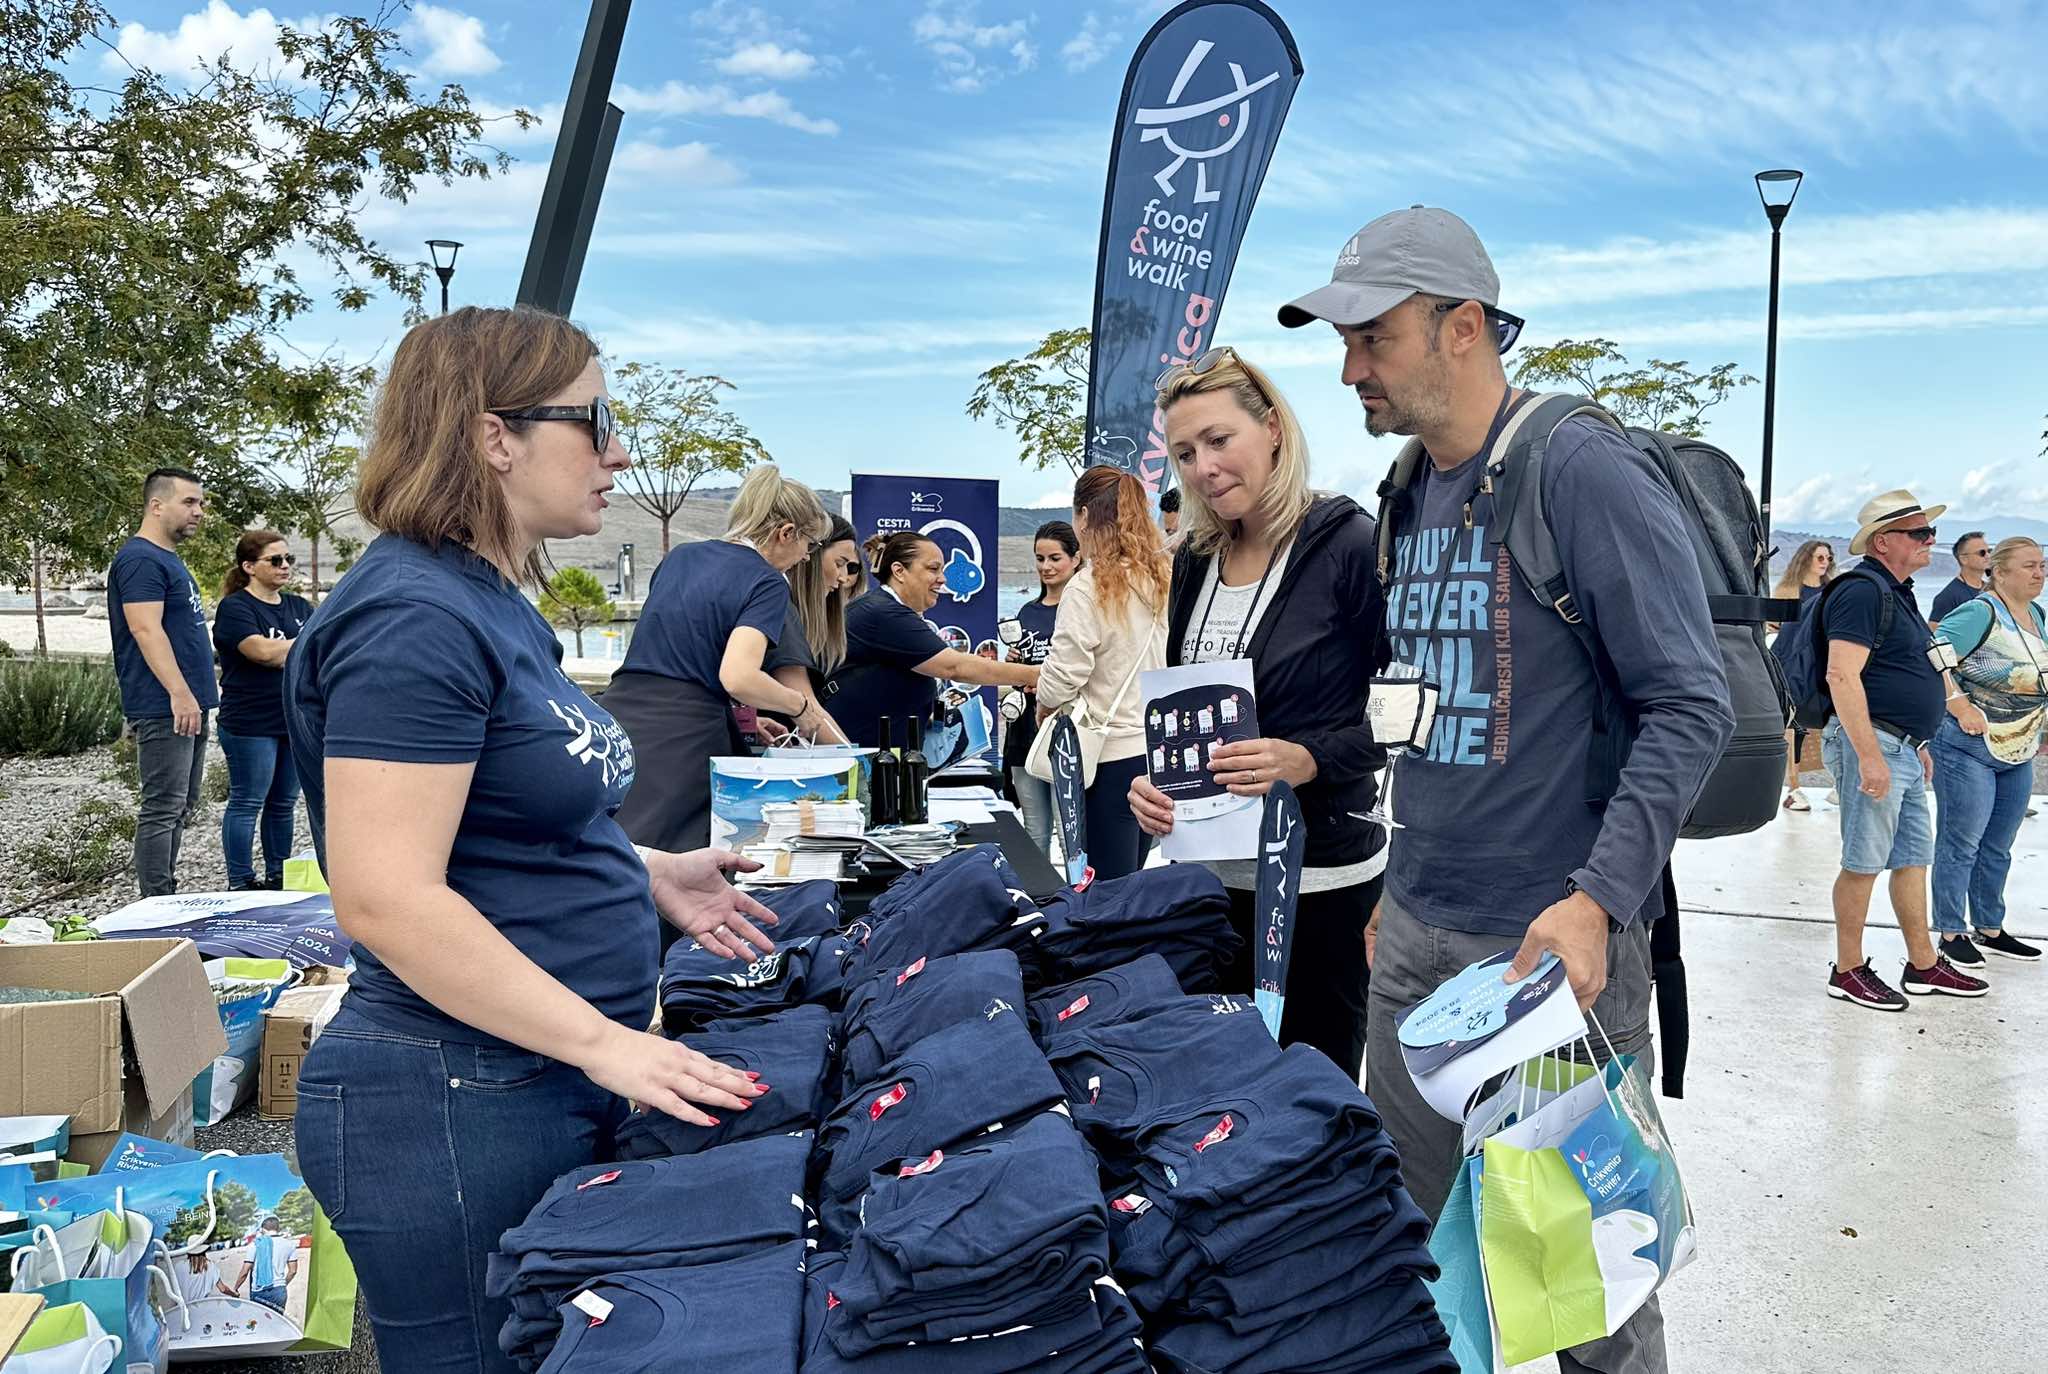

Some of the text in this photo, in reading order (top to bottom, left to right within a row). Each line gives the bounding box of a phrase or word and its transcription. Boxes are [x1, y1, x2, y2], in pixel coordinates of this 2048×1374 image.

[1143, 199, 1208, 240] food
[1130, 226, 1212, 270] & wine
[1128, 257, 1190, 291] walk
[877, 518, 911, 529] CESTA
[1386, 580, 1489, 631] NEVER
[1494, 608, 1511, 649] KLUB
[1408, 714, 1488, 766] NE
[296, 936, 332, 957] 2024.
[1587, 1154, 1622, 1188] Crikvenica
[1597, 1173, 1621, 1198] Riviera
